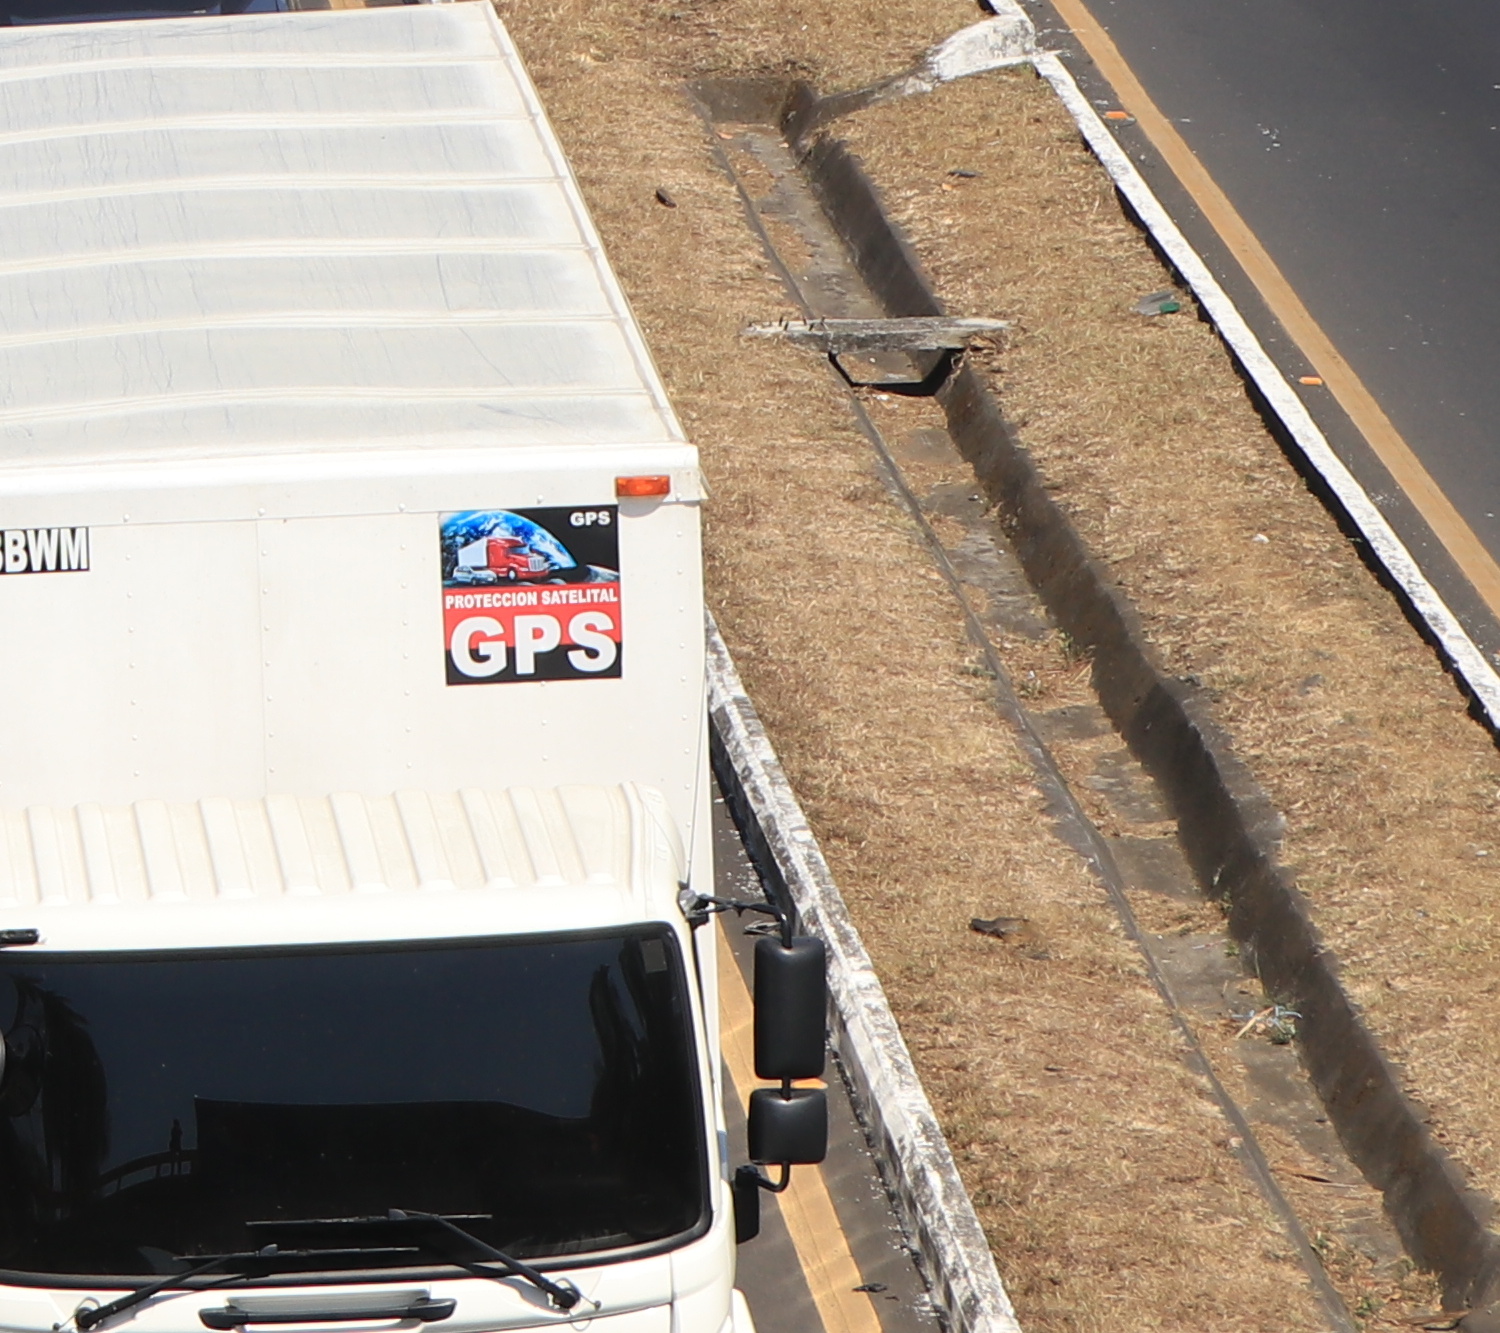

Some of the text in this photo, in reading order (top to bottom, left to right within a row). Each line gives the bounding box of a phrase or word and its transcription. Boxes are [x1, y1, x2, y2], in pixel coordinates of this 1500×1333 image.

[570, 511, 611, 527] GPS
[445, 588, 618, 609] PROTECCION SATELITAL
[450, 611, 617, 678] GPS
